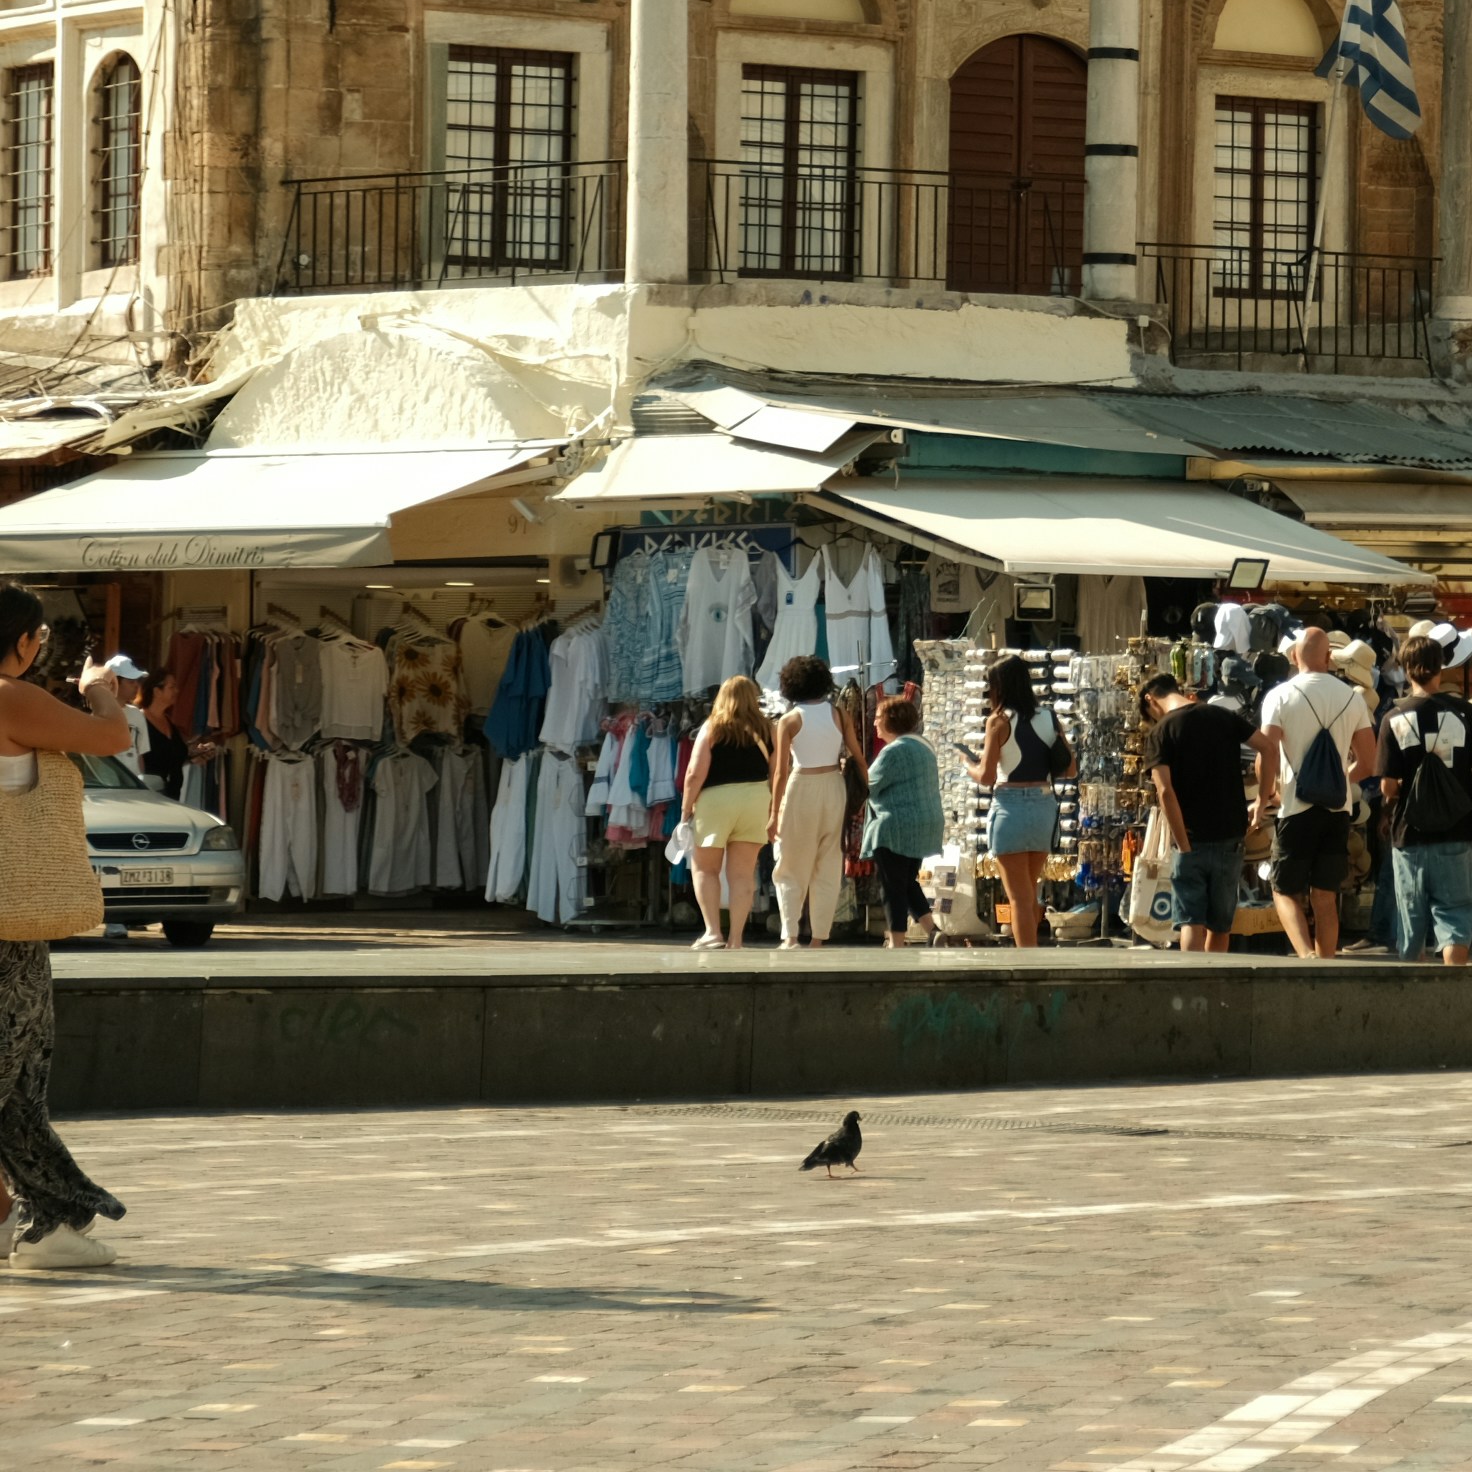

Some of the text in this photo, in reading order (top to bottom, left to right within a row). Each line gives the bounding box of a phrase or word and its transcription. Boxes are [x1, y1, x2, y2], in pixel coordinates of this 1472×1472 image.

[79, 535, 265, 568] Cotton club Dimitris
